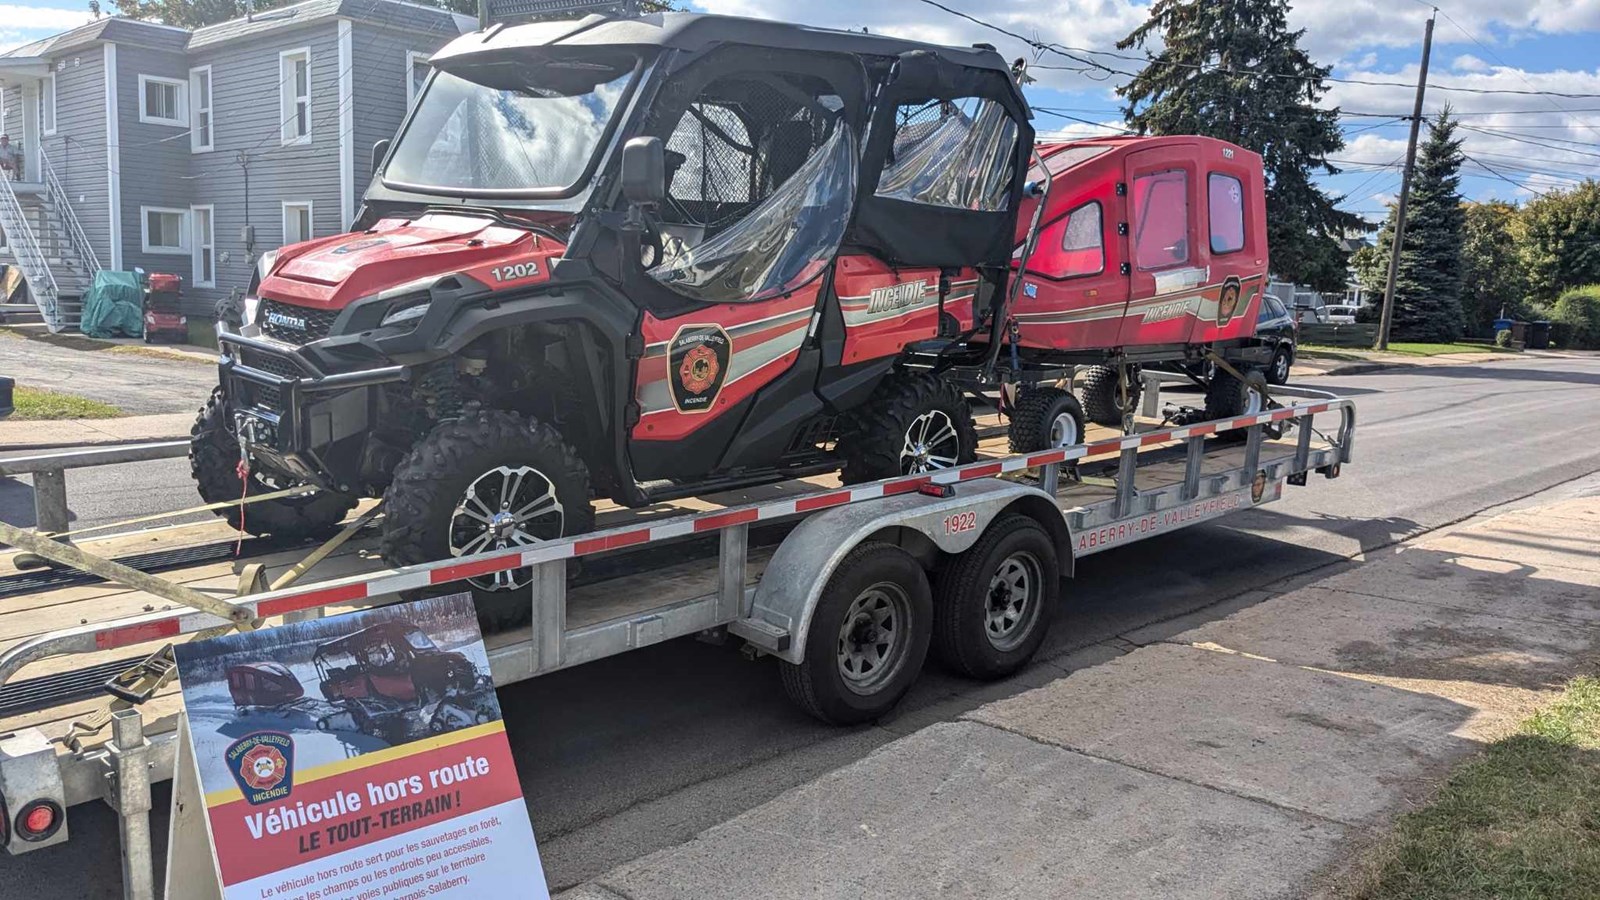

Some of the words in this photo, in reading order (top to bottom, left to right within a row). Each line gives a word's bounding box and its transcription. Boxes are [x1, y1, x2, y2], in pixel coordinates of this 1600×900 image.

[491, 262, 539, 281] 1202
[866, 279, 928, 314] INCENDIE
[1142, 301, 1192, 323] INCENDIE
[268, 312, 305, 328] HONDA
[944, 511, 976, 535] 1922
[1073, 493, 1240, 551] ABERRY-DE-VALLEYFIELD
[228, 735, 291, 760] SALABERRY-DE-VALLEYFIELD
[244, 789, 362, 840] Véhicule
[367, 774, 424, 807] hors
[429, 755, 490, 789] route
[252, 786, 289, 802] INCENDIE
[298, 831, 321, 854] LE
[327, 793, 453, 845] TOUT-TERRAIN
[456, 791, 462, 808] !
[261, 888, 273, 899] Le
[275, 875, 315, 893] véhicule
[317, 867, 338, 881] hors
[340, 860, 364, 874] route
[366, 853, 383, 866] sert
[385, 847, 404, 862] pour
[406, 843, 419, 853] les
[421, 827, 467, 848] sauvetages
[469, 824, 479, 834] en
[480, 816, 502, 830] forêt,
[323, 878, 359, 897] champs
[361, 874, 373, 885] ou
[374, 868, 388, 880] les
[390, 857, 424, 875] endroits
[426, 852, 442, 865] peu
[444, 836, 493, 857] accessibles,
[383, 873, 424, 896] publiques
[426, 868, 440, 880] sur
[441, 864, 449, 875] le
[451, 852, 486, 872] territoire
